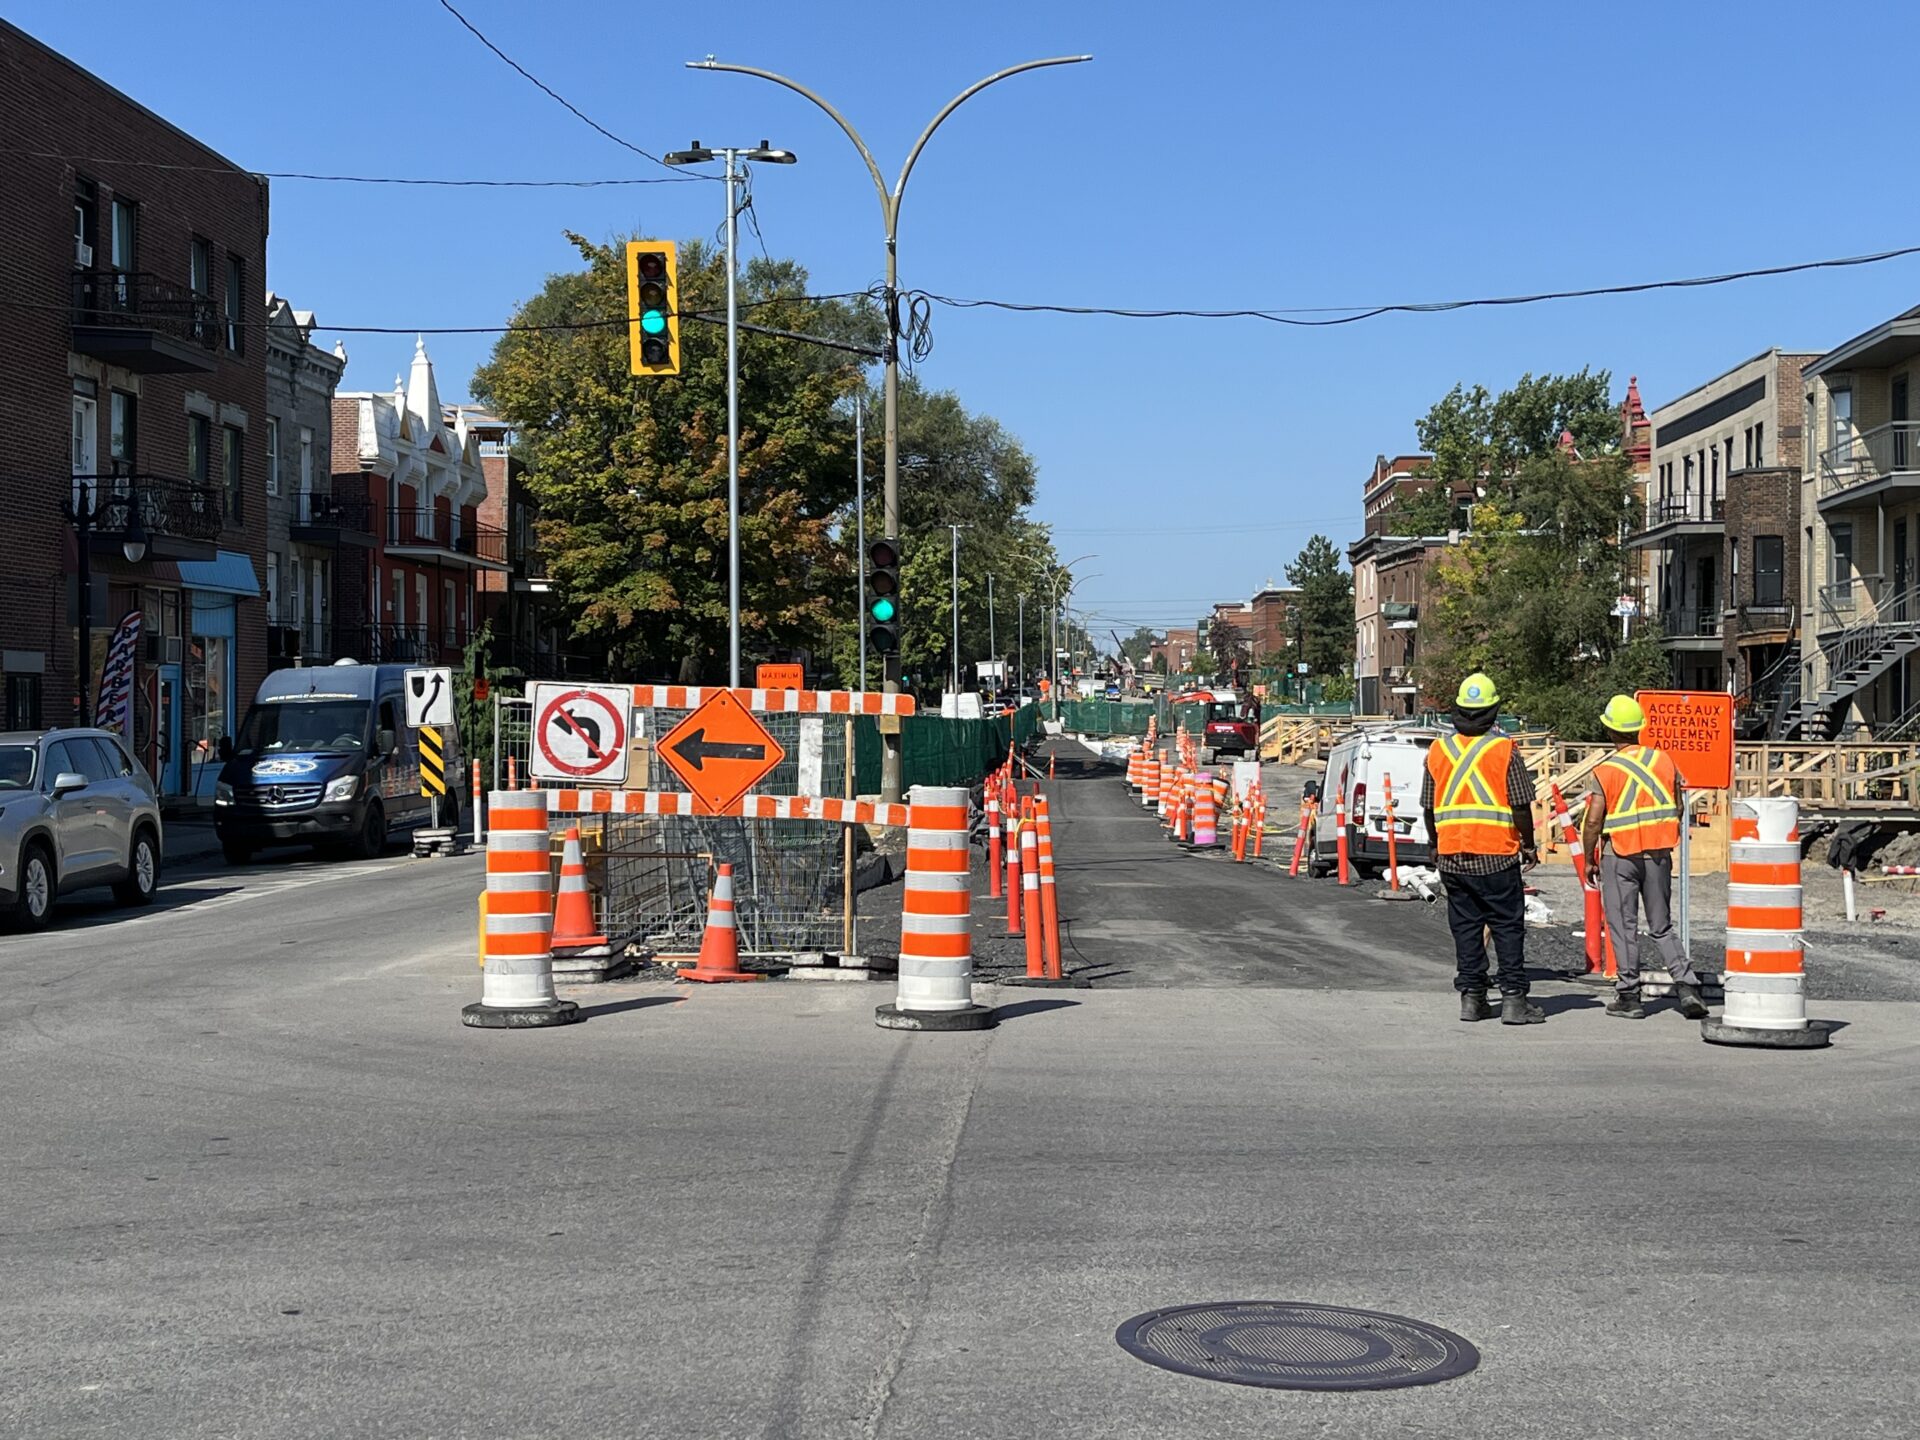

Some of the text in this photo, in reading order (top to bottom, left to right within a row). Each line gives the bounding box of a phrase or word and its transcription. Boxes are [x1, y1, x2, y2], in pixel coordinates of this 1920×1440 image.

[105, 626, 132, 722] BARBER
[1694, 705, 1721, 716] AUX
[1650, 716, 1717, 729] RIVERAINS
[1648, 728, 1720, 741] SEULEMENT
[1654, 740, 1711, 752] ADRESSE
